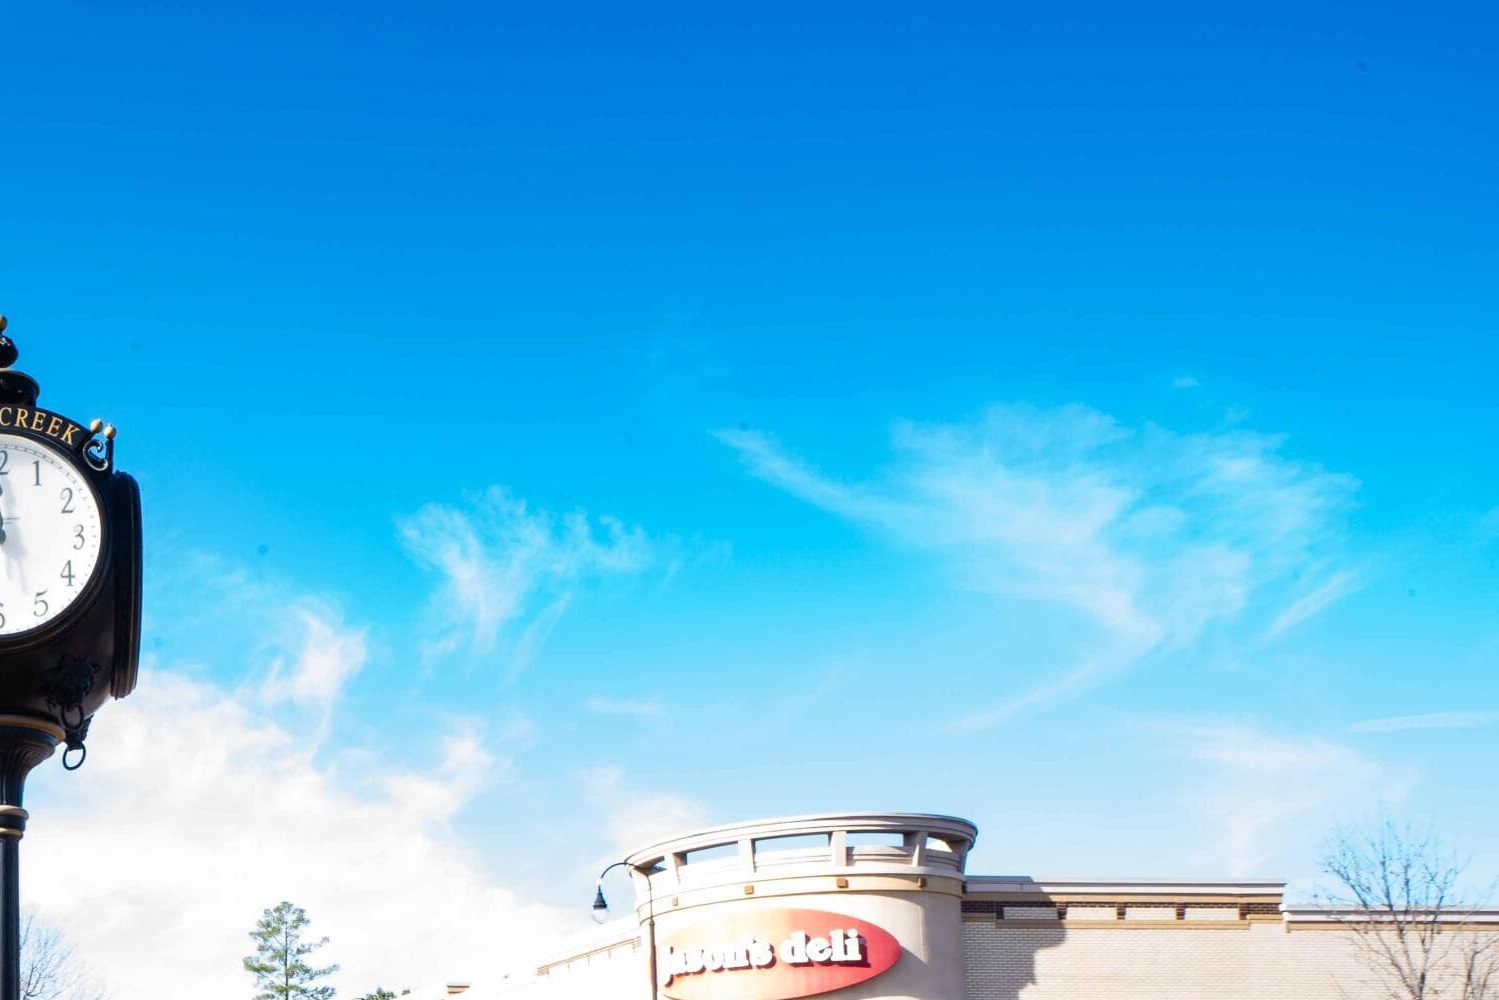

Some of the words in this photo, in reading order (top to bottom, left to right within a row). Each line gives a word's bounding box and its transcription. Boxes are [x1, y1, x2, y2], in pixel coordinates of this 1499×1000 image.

[32, 460, 42, 486] 1
[60, 487, 75, 514] 2
[73, 524, 85, 551] 3
[60, 560, 76, 587] 4
[33, 589, 49, 617] 5
[778, 928, 863, 965] deli
